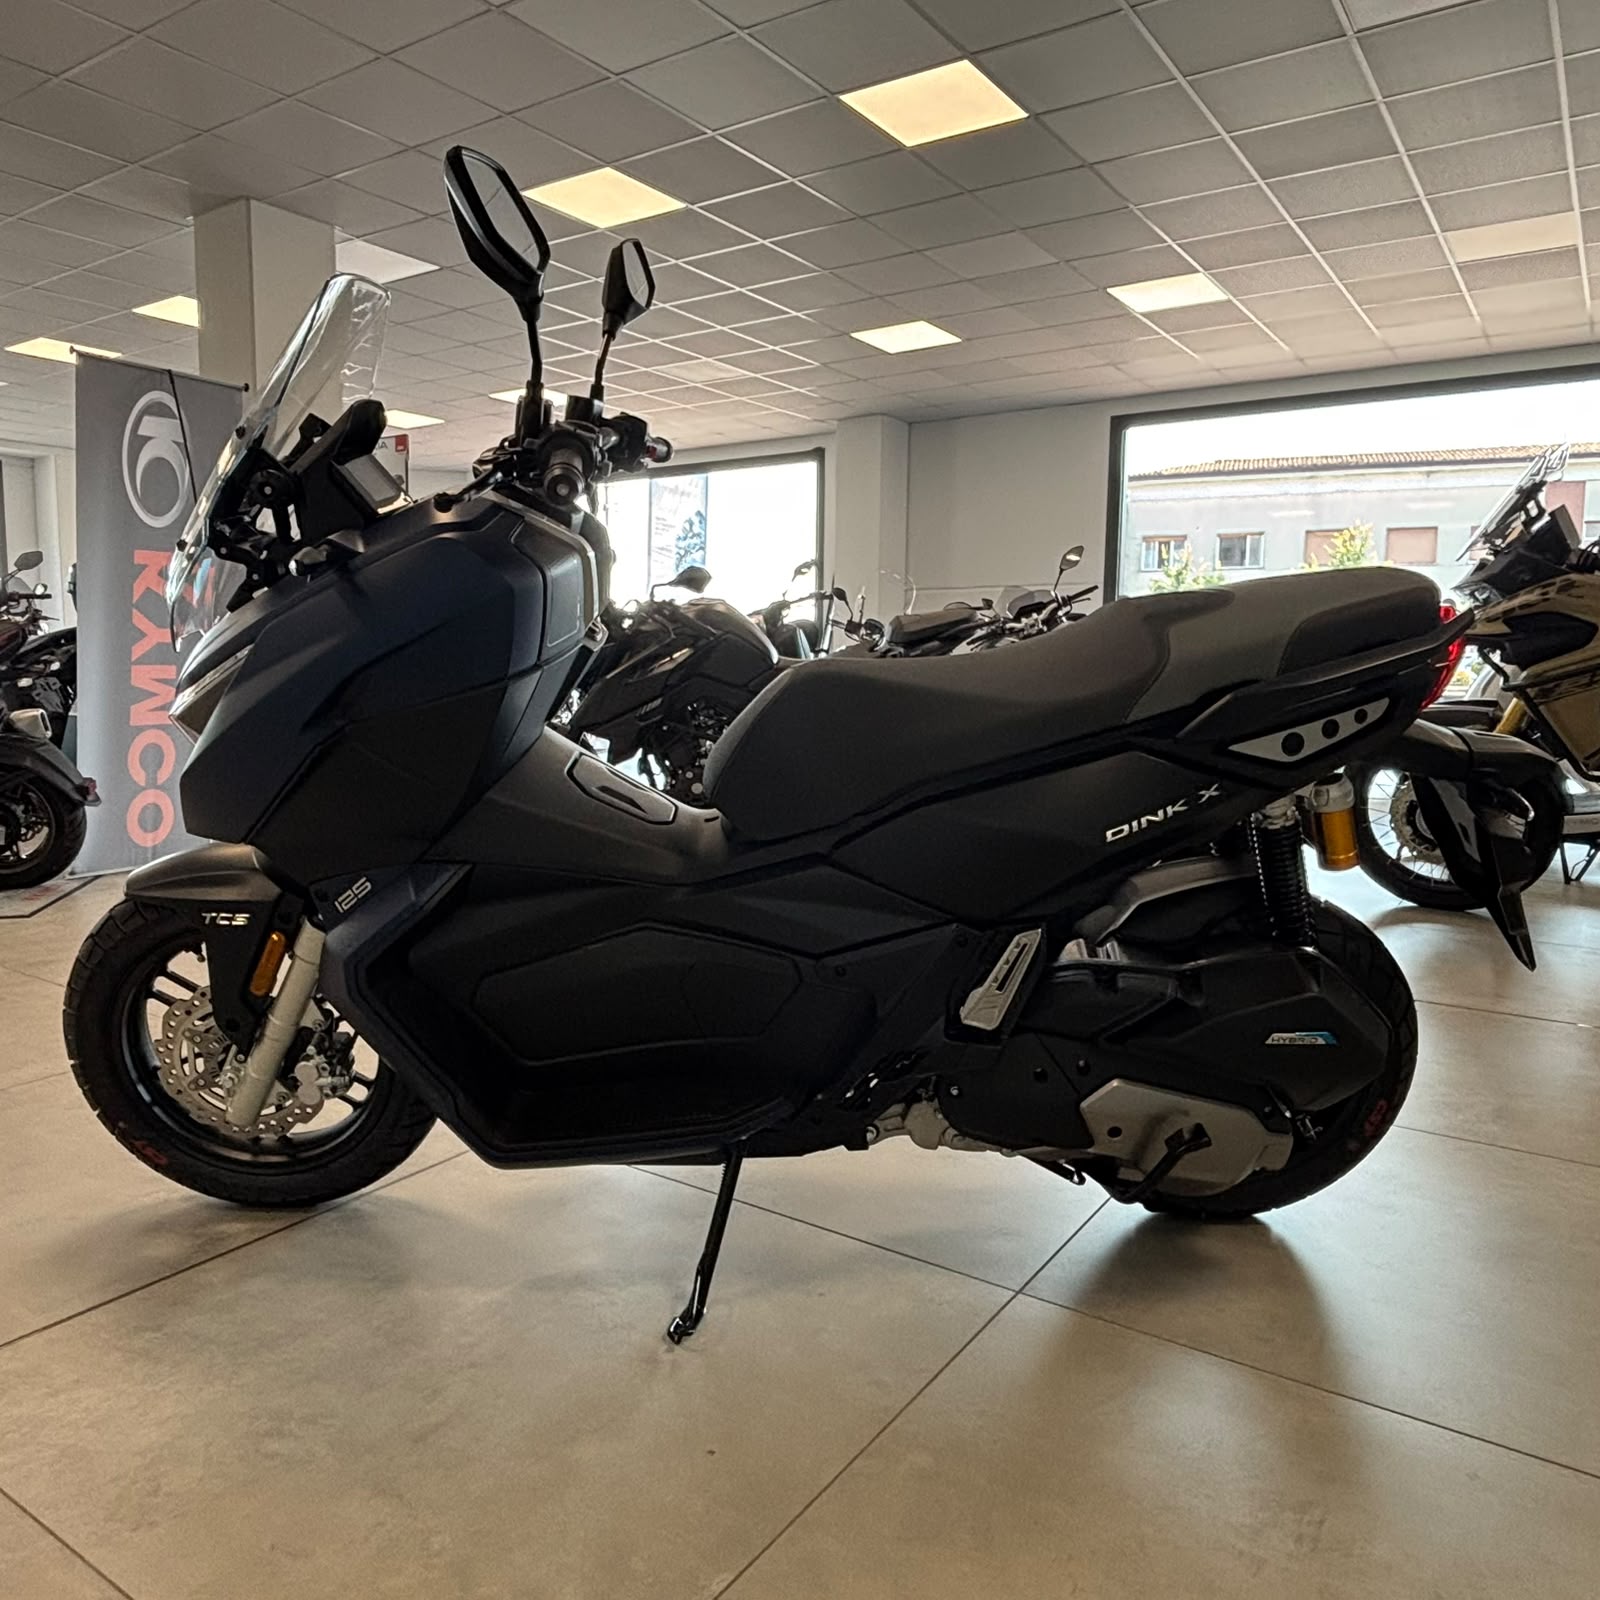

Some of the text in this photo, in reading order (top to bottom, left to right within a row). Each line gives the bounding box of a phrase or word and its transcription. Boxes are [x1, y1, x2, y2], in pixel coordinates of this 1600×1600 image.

[1105, 783, 1222, 843] DINK X
[334, 876, 373, 914] 125
[201, 912, 251, 926] TCS
[1270, 1036, 1319, 1045] HYBRID
